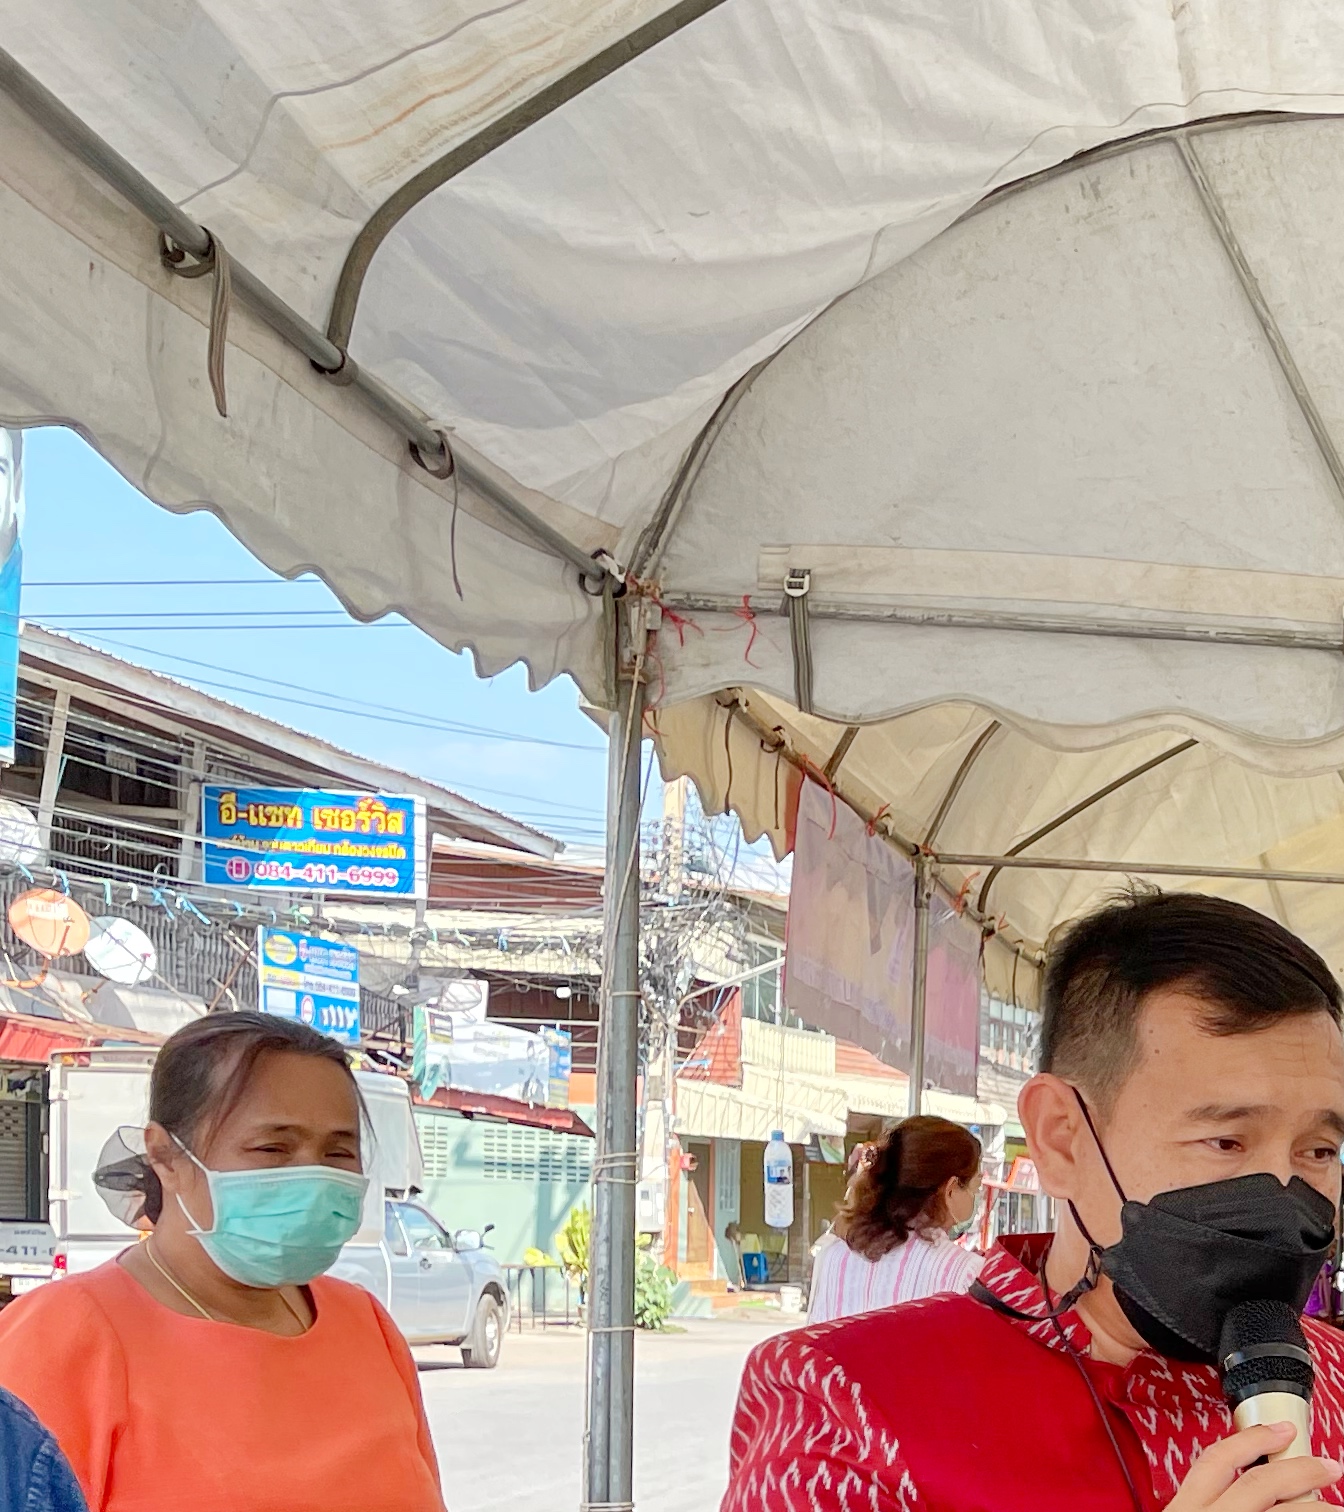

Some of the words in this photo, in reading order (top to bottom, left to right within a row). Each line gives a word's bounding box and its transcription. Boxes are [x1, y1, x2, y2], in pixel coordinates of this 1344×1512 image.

[312, 796, 406, 836] เซอร์วิส
[254, 861, 399, 887] 084-411-6999
